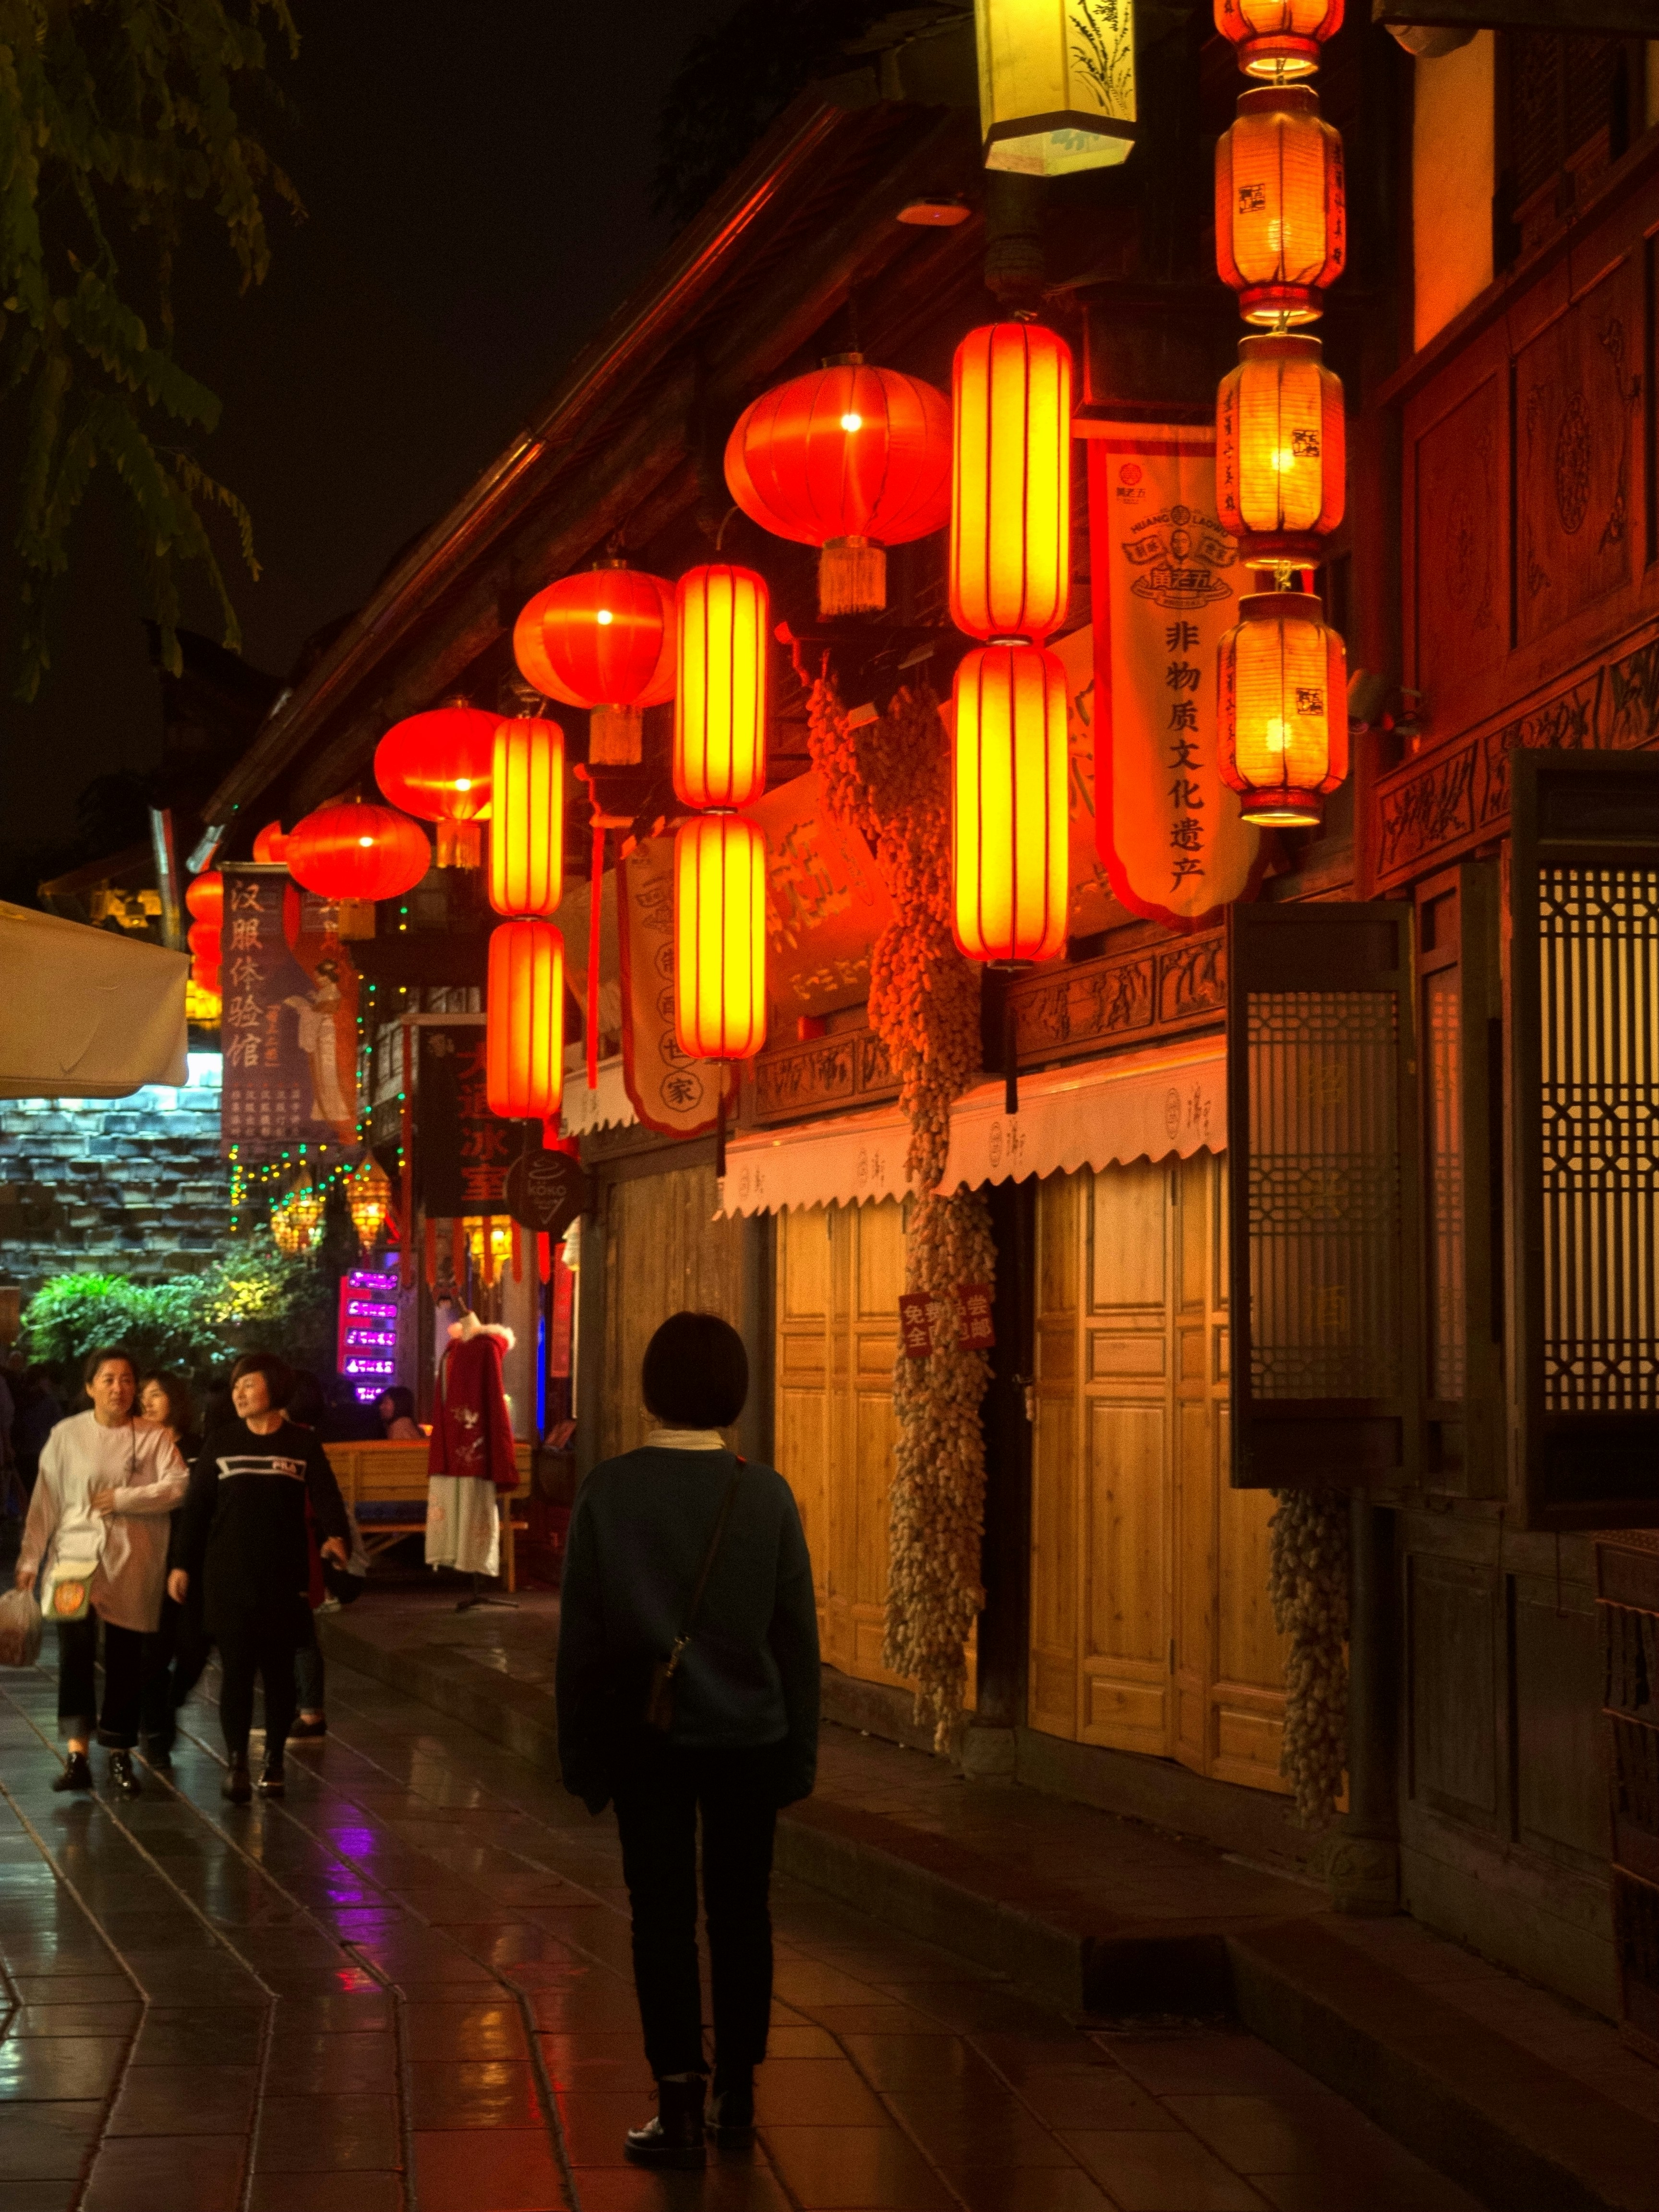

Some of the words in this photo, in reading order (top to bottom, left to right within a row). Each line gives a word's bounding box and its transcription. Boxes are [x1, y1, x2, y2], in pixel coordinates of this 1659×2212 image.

[1131, 514, 1169, 534] HUANG
[1165, 621, 1205, 893] 非物质文化遗产
[227, 879, 264, 1068] 汉服体验馆
